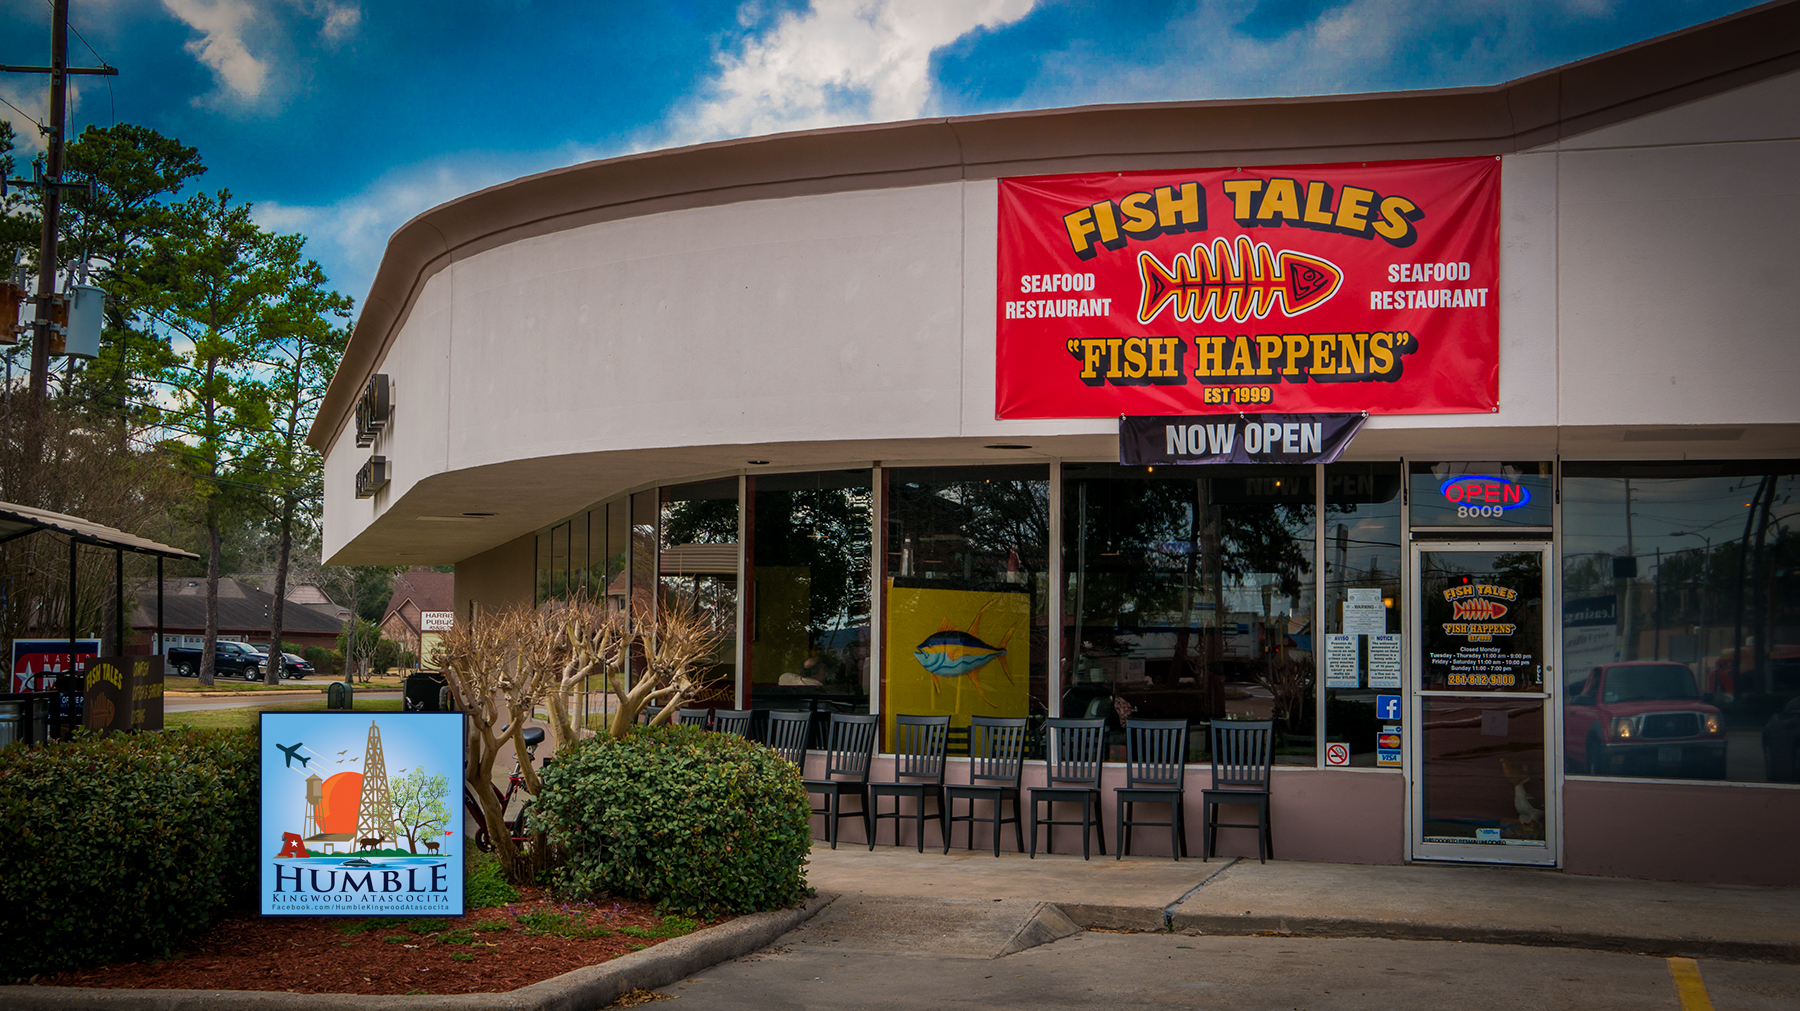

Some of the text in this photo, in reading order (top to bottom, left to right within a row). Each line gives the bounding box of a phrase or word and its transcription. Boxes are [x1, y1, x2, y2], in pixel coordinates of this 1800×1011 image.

[1063, 177, 1426, 261] FISH TALES
[1388, 262, 1470, 283] SEAFOOD
[1020, 273, 1095, 294] SEAFOOD
[1005, 298, 1112, 319] RESTAURANT
[1370, 288, 1489, 310] RESTAURANT
[1066, 330, 1419, 387] “FISH HAPPENS”
[1203, 386, 1274, 404] EST 1999
[1166, 422, 1323, 455] NOW OPEN
[1445, 484, 1520, 503] OPEN
[1457, 505, 1504, 518] 8009
[1443, 585, 1518, 602] FISH TALES
[86, 664, 101, 692] FISH
[102, 663, 123, 690] TALES
[1448, 673, 1516, 686] 281-812-9100
